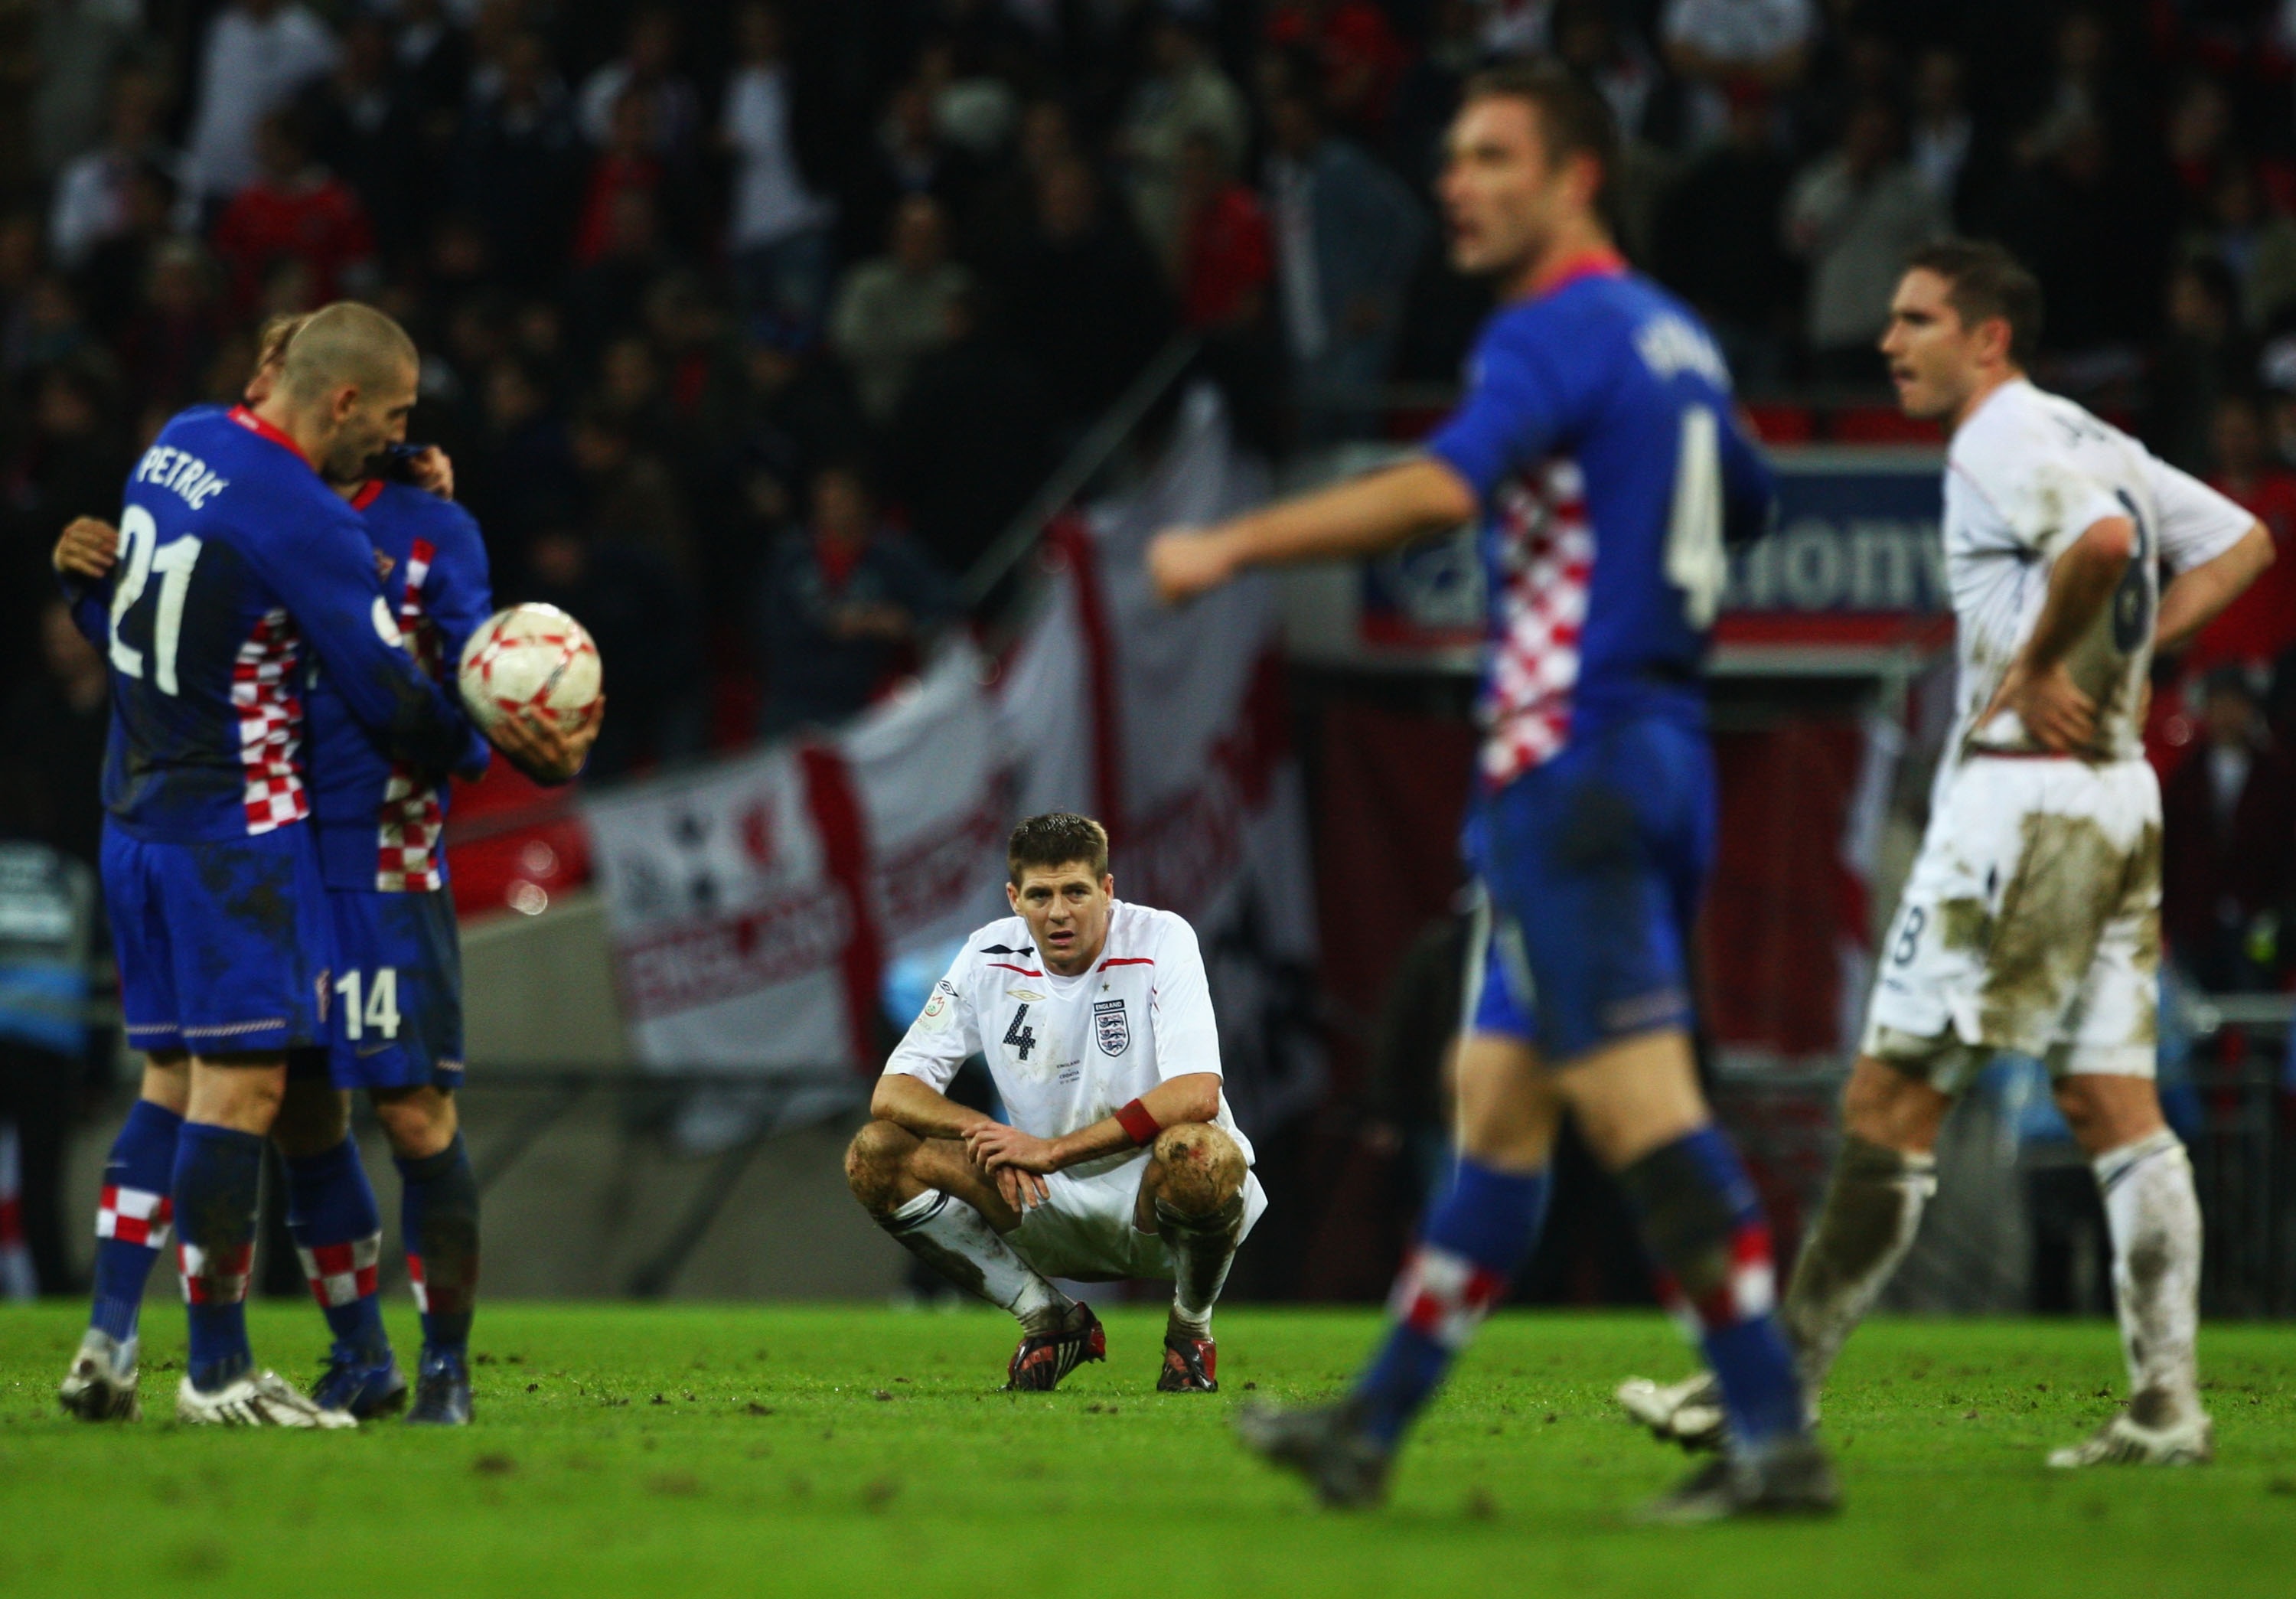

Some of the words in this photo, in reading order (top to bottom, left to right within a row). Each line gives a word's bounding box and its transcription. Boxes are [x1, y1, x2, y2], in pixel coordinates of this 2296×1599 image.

[109, 504, 203, 697] 21
[1893, 906, 1925, 967] 8
[334, 966, 401, 1041] 14
[1003, 1003, 1036, 1061] 4
[1095, 1001, 1122, 1011] ENGLAND
[1056, 1059, 1080, 1069] ENGLAND
